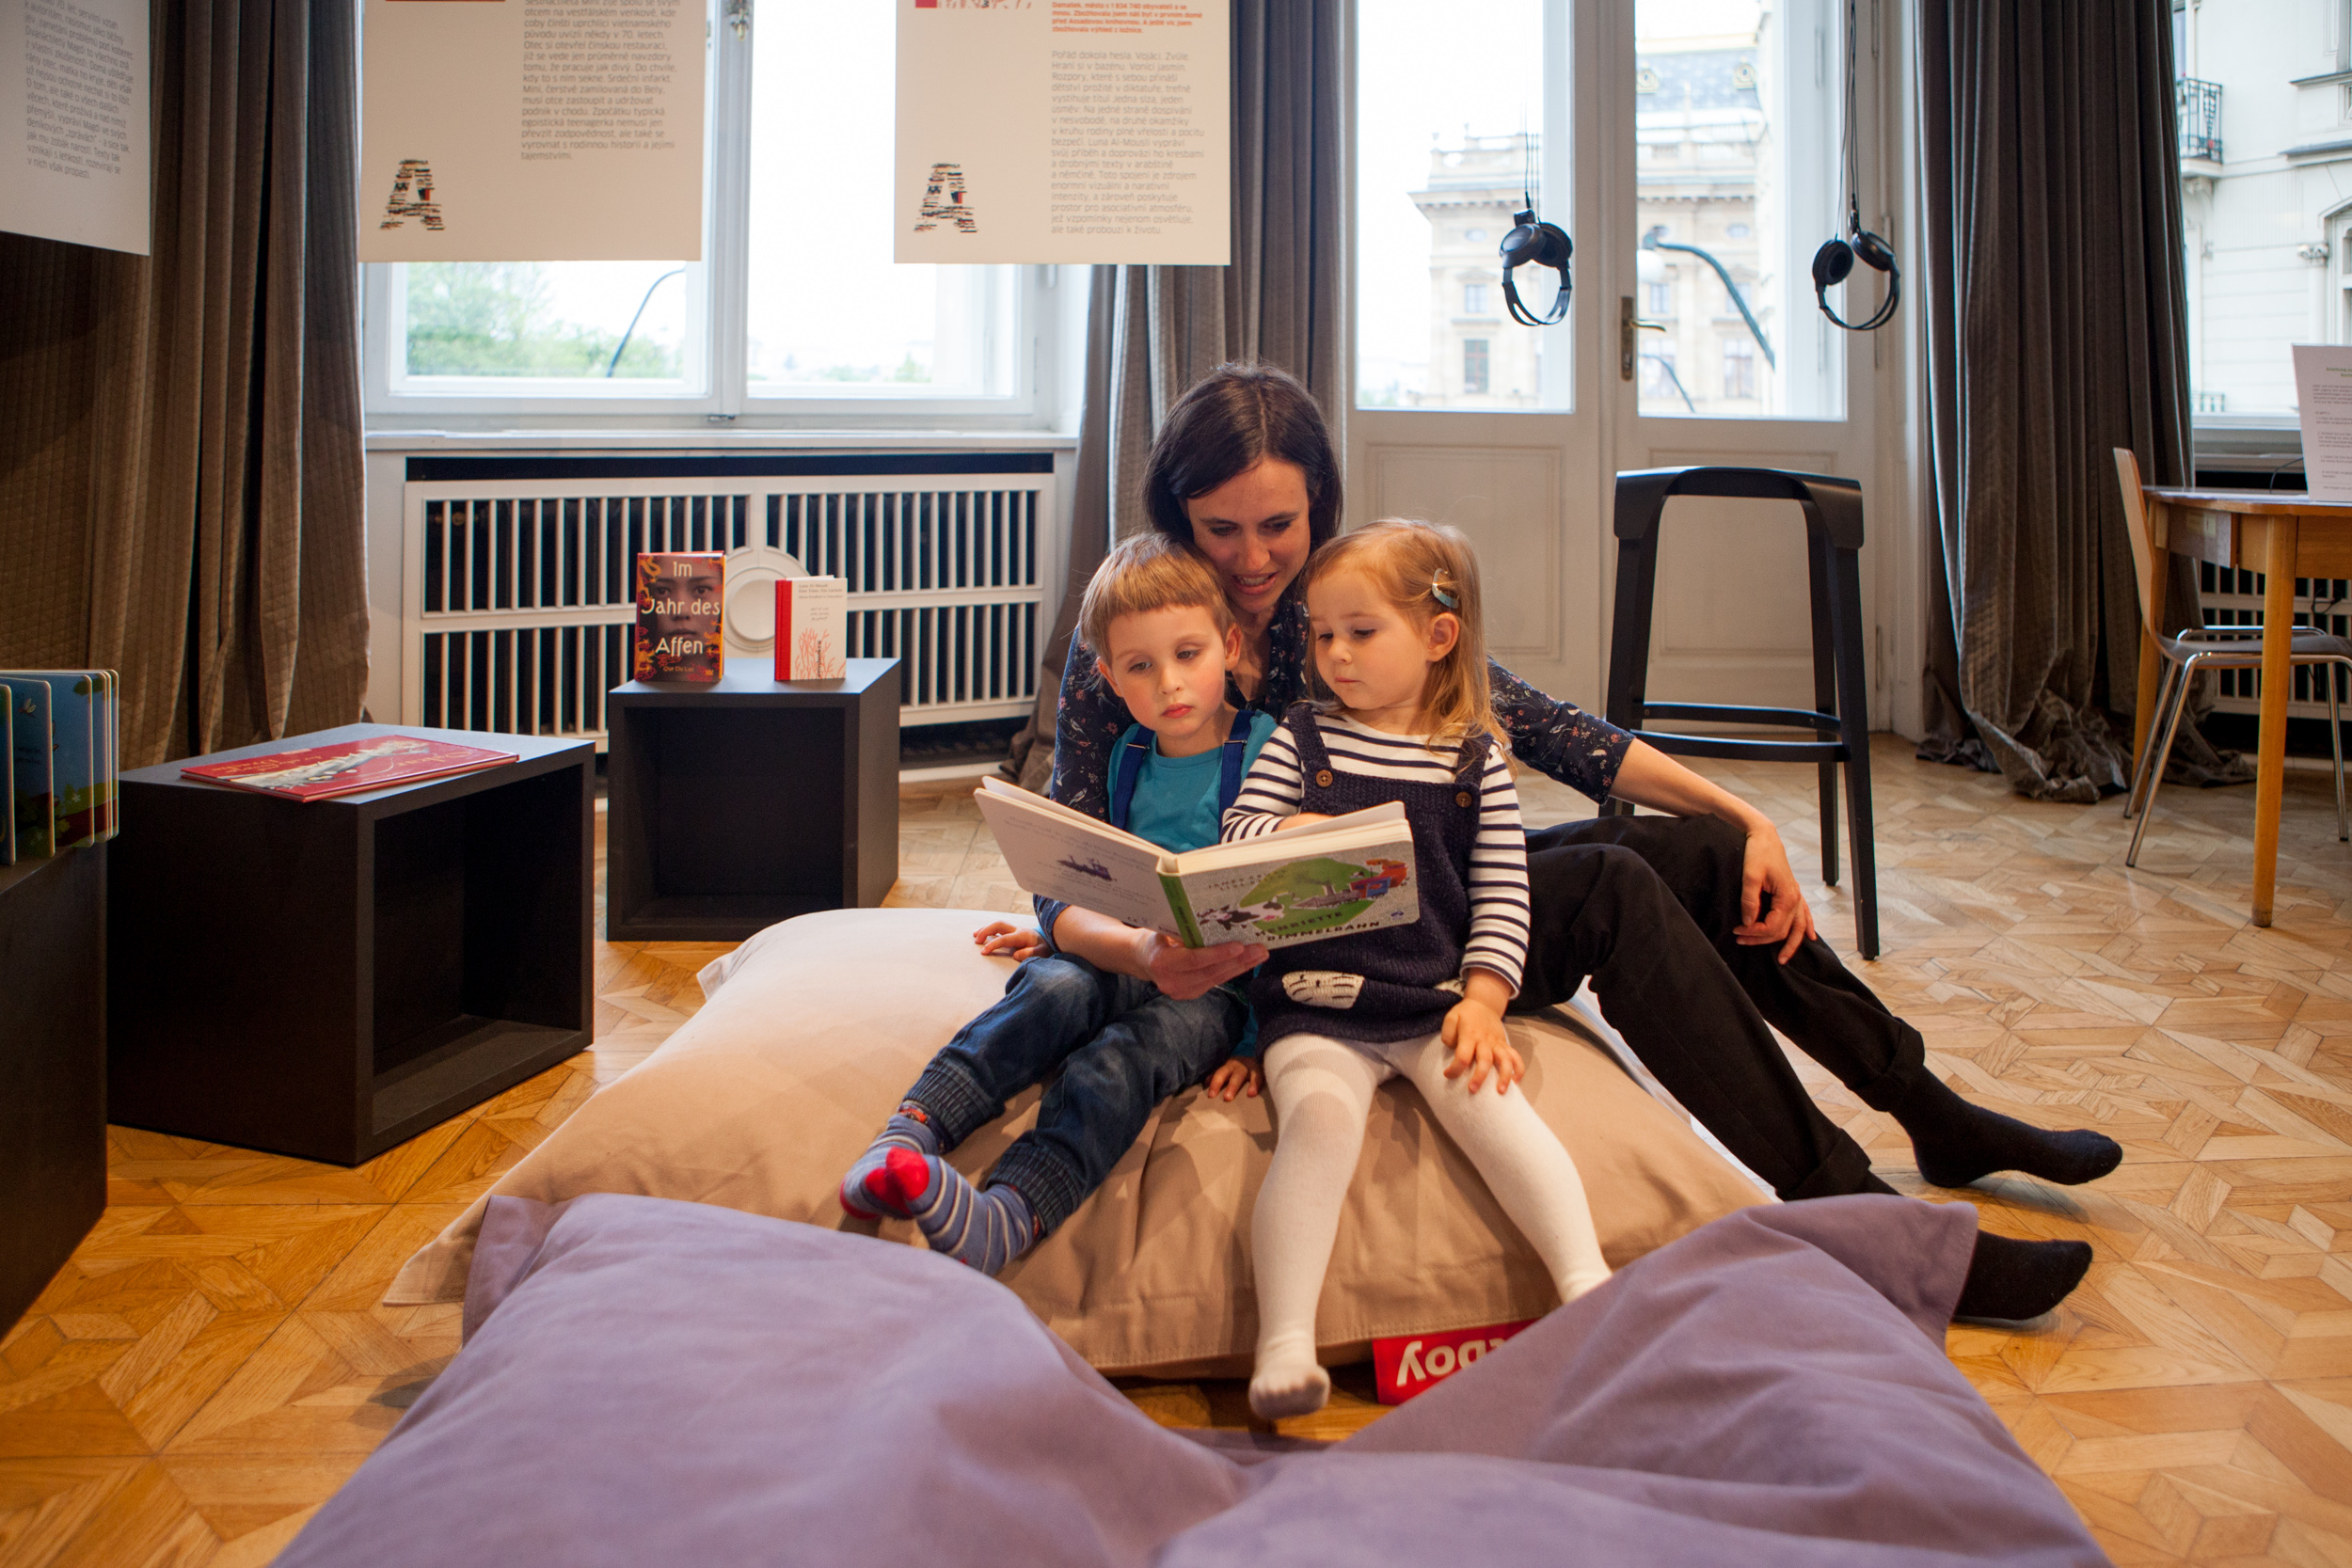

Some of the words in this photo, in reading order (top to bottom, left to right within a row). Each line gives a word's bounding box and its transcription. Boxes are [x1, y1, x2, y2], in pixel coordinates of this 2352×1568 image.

[673, 562, 692, 577] Im
[641, 598, 684, 614] Jahr
[691, 598, 721, 615] des
[655, 637, 704, 658] Affen
[1255, 912, 1342, 937] HENRIETTE
[1268, 922, 1379, 941] BIMMELBAHN
